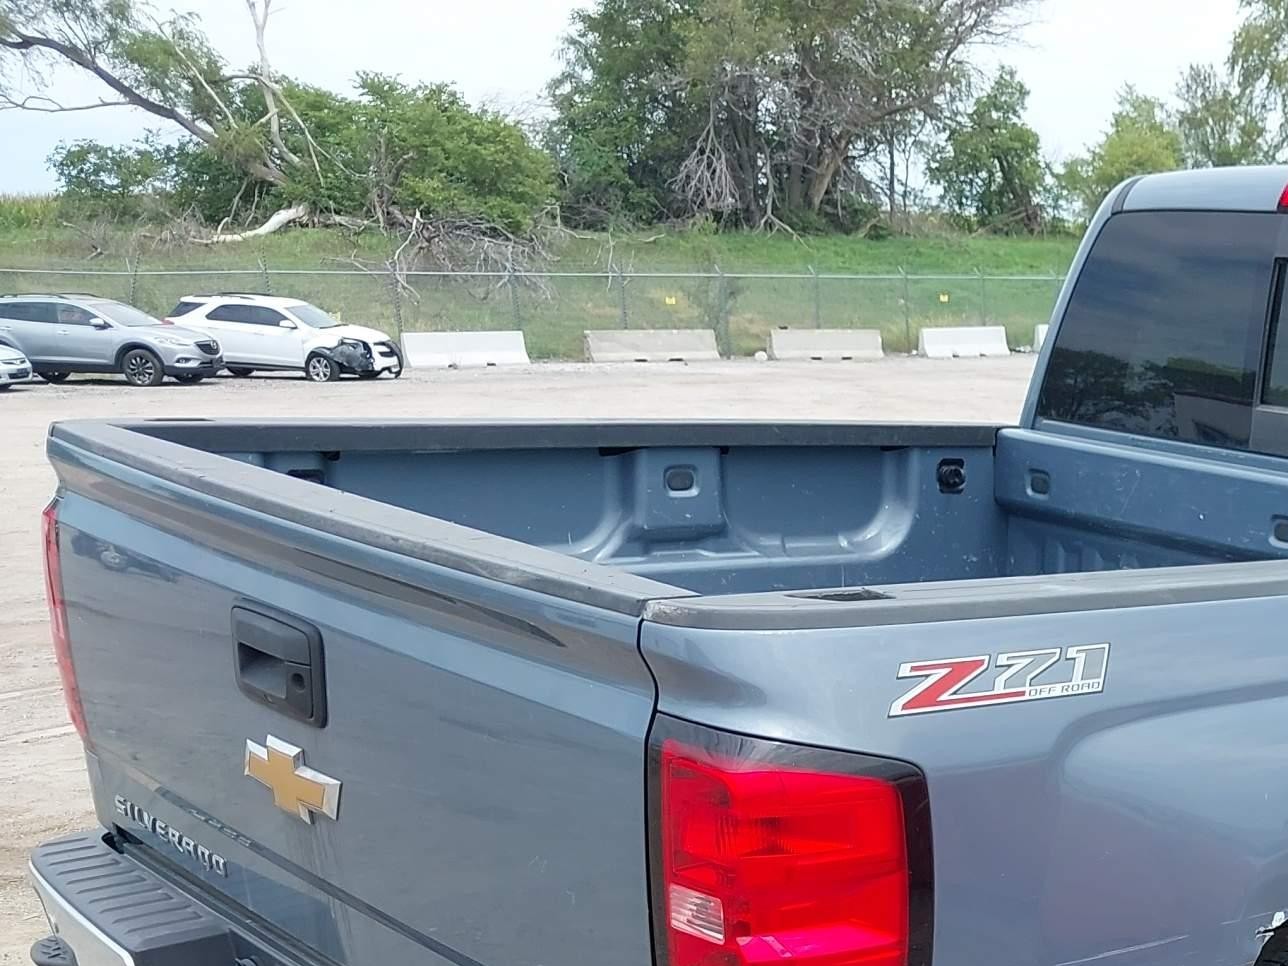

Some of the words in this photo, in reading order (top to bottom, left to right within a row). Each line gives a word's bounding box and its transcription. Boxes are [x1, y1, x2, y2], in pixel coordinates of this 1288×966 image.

[888, 642, 1111, 718] Z71
[1028, 685, 1057, 698] OFF
[1061, 680, 1101, 693] ROAD
[114, 794, 228, 878] SILVERADO
